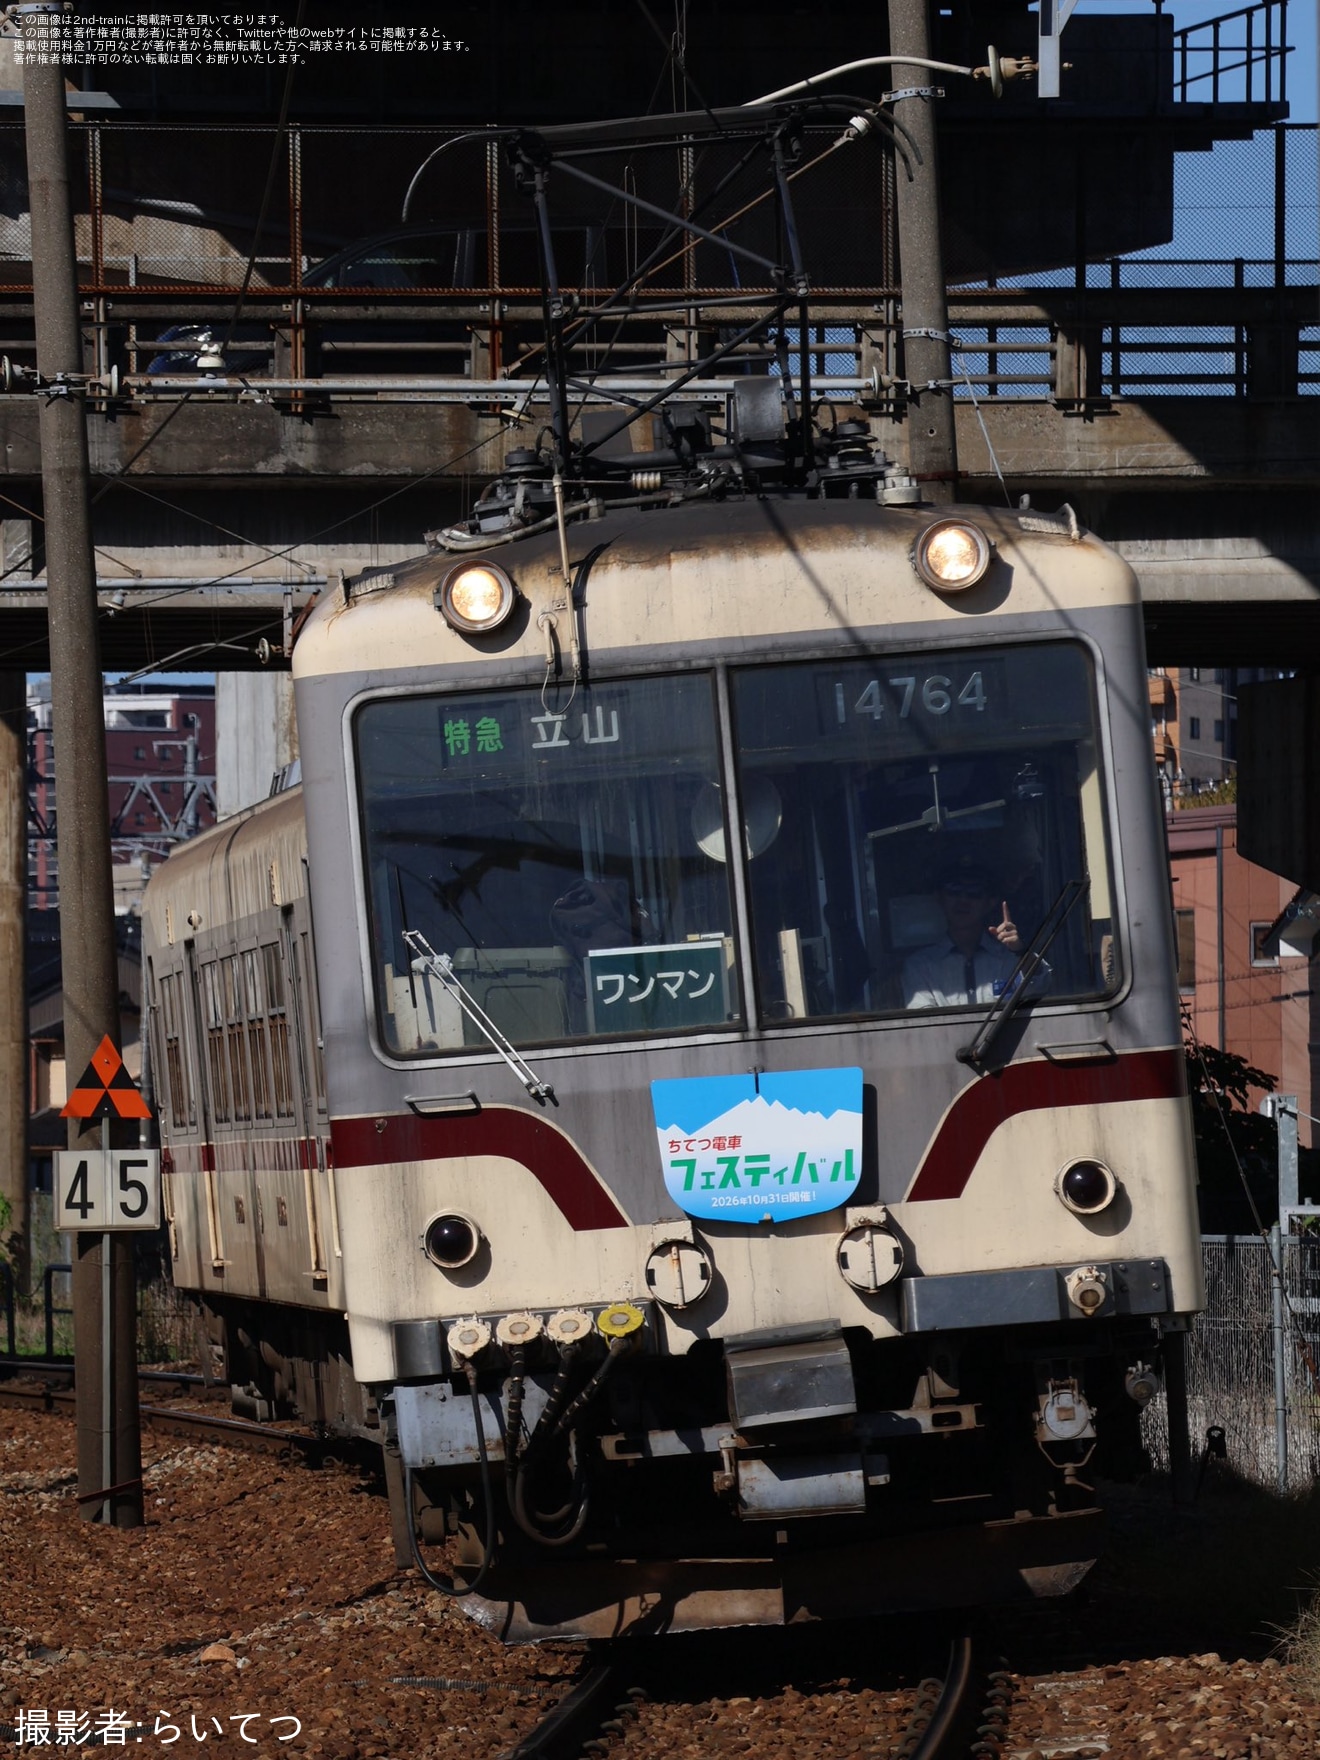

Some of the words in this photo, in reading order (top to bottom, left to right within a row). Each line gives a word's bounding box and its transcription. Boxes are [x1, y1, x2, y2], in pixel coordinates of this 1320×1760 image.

[834, 671, 988, 724] 14764
[443, 716, 504, 756] 特急
[530, 705, 620, 749] 立山
[596, 969, 716, 1005] ワンマン
[668, 1135, 742, 1154] ちてつ電車
[65, 1159, 149, 1219] 45
[670, 1148, 856, 1192] フェスティバル
[711, 1190, 817, 1208] 2026年10月31日開催!
